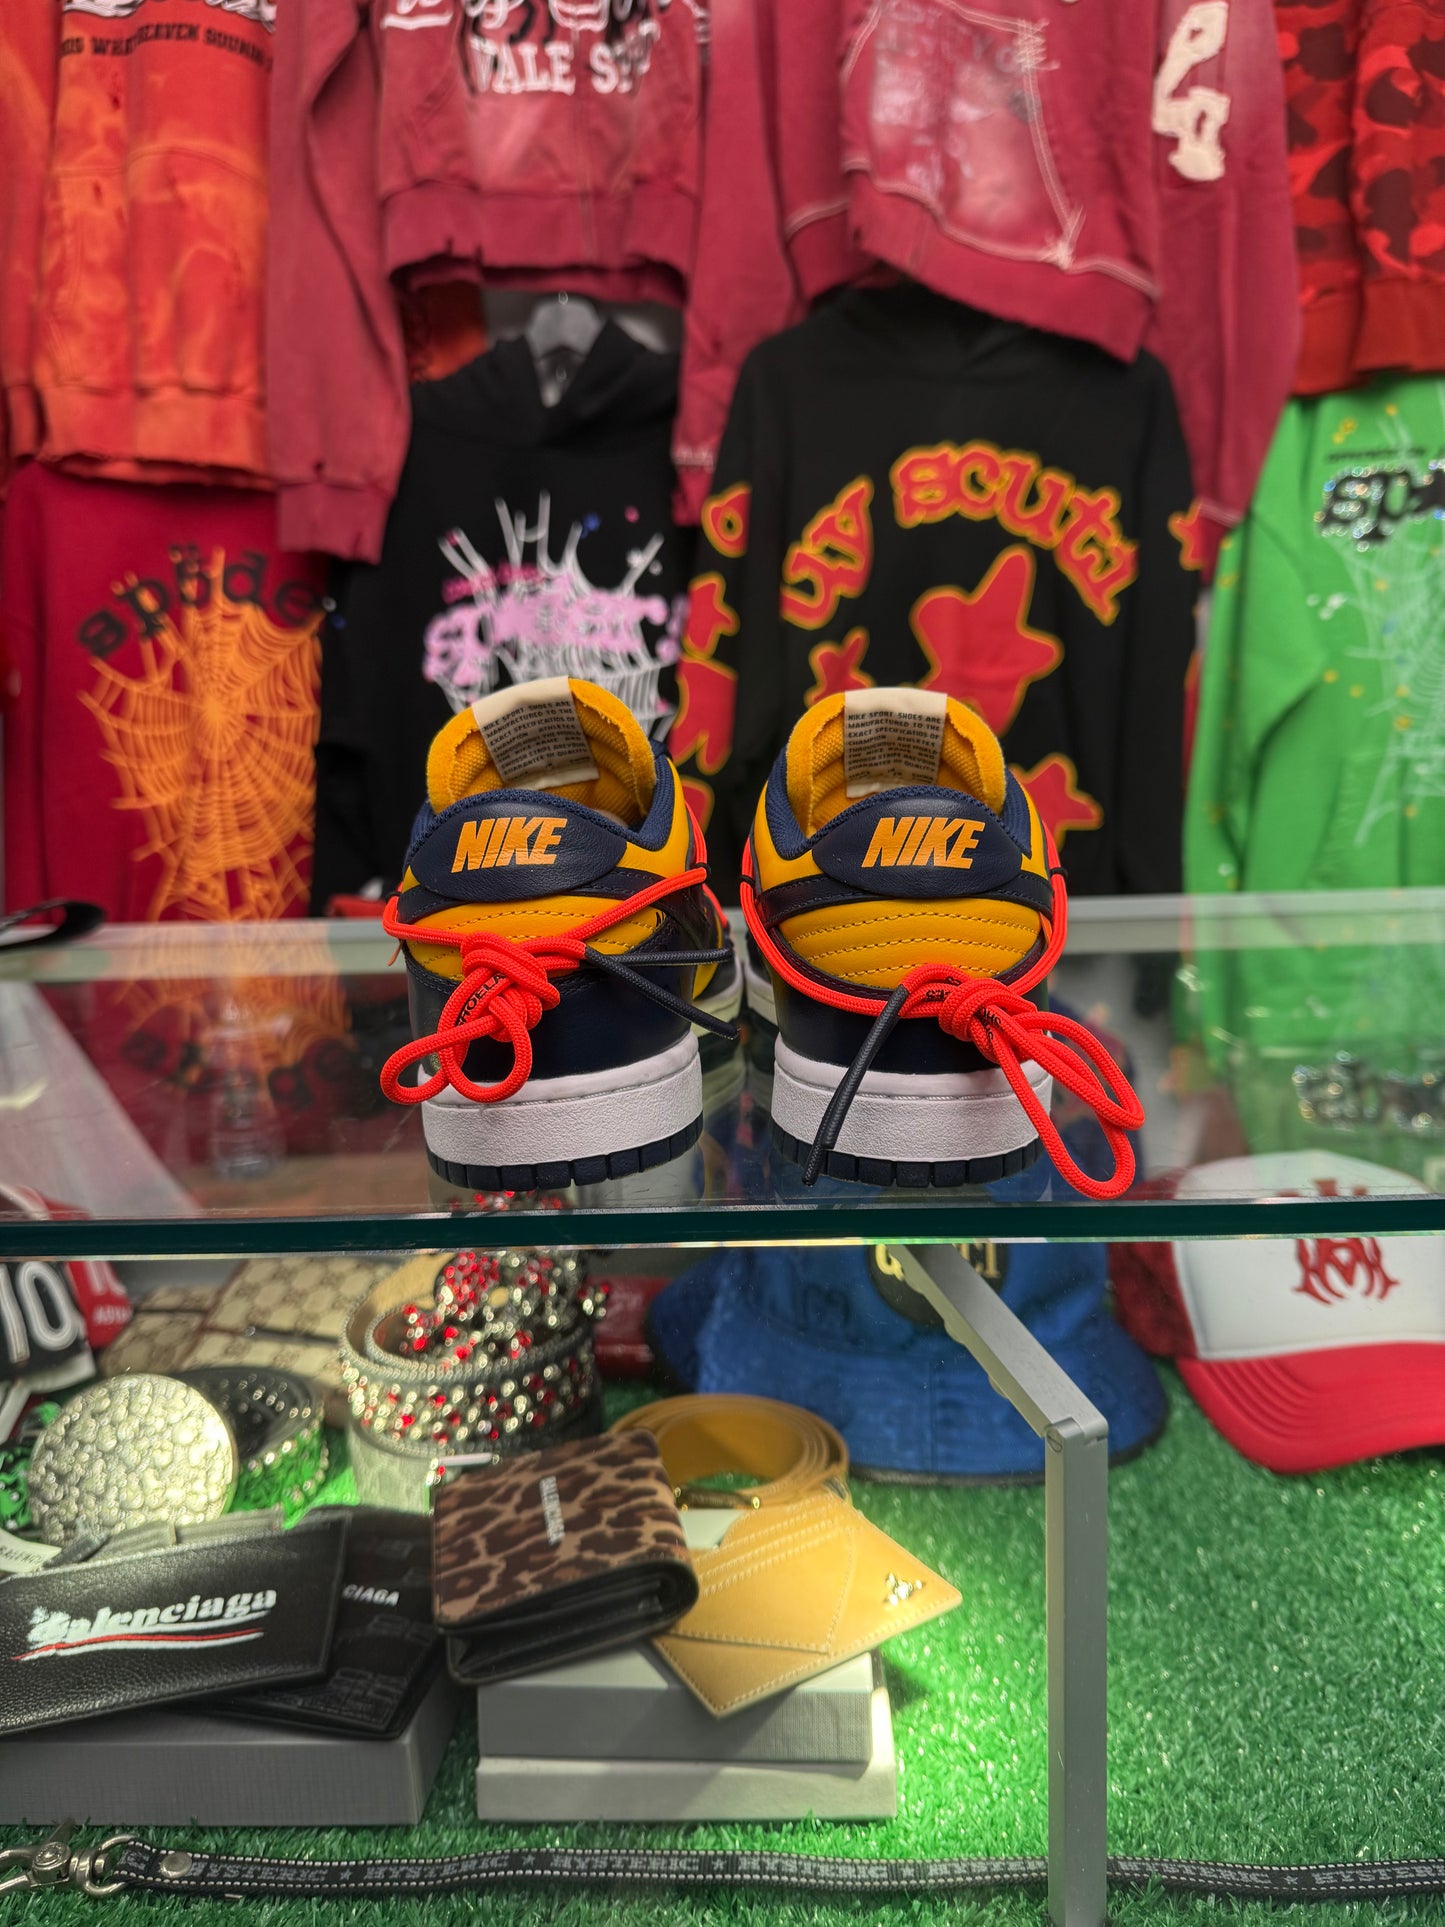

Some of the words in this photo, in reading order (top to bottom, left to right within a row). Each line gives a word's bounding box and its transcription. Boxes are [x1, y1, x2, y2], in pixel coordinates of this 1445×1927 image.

[483, 718, 503, 731] NIKE
[502, 708, 524, 723] SPORT
[528, 702, 553, 711] SHOES
[487, 711, 544, 738] MANUFACTURED
[848, 713, 866, 721] NIKE
[898, 712, 922, 720] SHOES
[925, 715, 941, 724] ARE
[848, 718, 910, 729] MANUFACTURED
[490, 730, 512, 746] EXACT
[493, 732, 529, 752] CHAMPION
[539, 723, 576, 733] ATHLETES
[848, 729, 872, 738] EXACT
[848, 734, 886, 746] CHAMPION
[451, 816, 568, 873] NIKE
[861, 816, 986, 869] NIKE
[551, 1854, 700, 1871] HYSTERIC
[737, 1856, 889, 1880] HYSTERIC
[927, 1860, 1047, 1877] HYSTER
